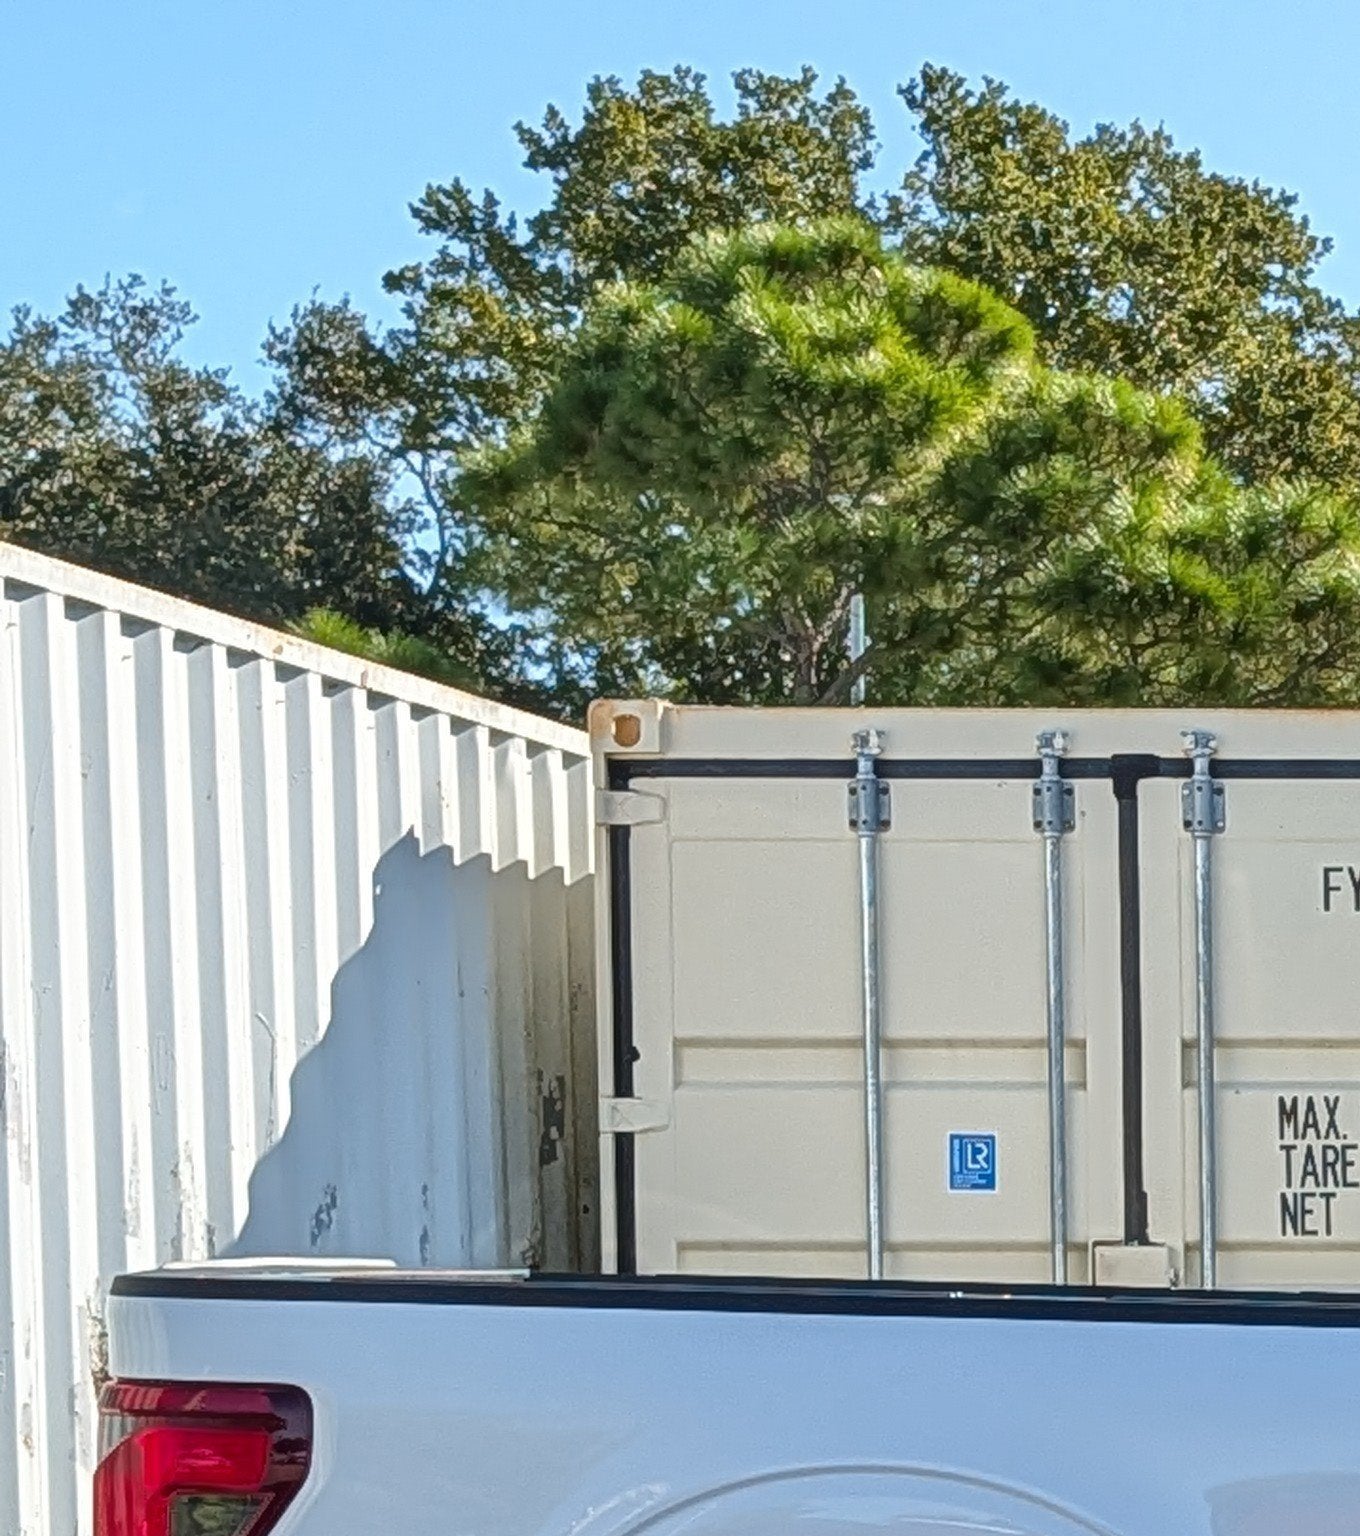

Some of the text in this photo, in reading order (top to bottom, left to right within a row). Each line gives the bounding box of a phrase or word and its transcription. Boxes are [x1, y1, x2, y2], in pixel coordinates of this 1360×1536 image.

[1278, 1095, 1348, 1141] MAX.
[1279, 1143, 1360, 1189] TARE
[1279, 1191, 1337, 1237] NET
